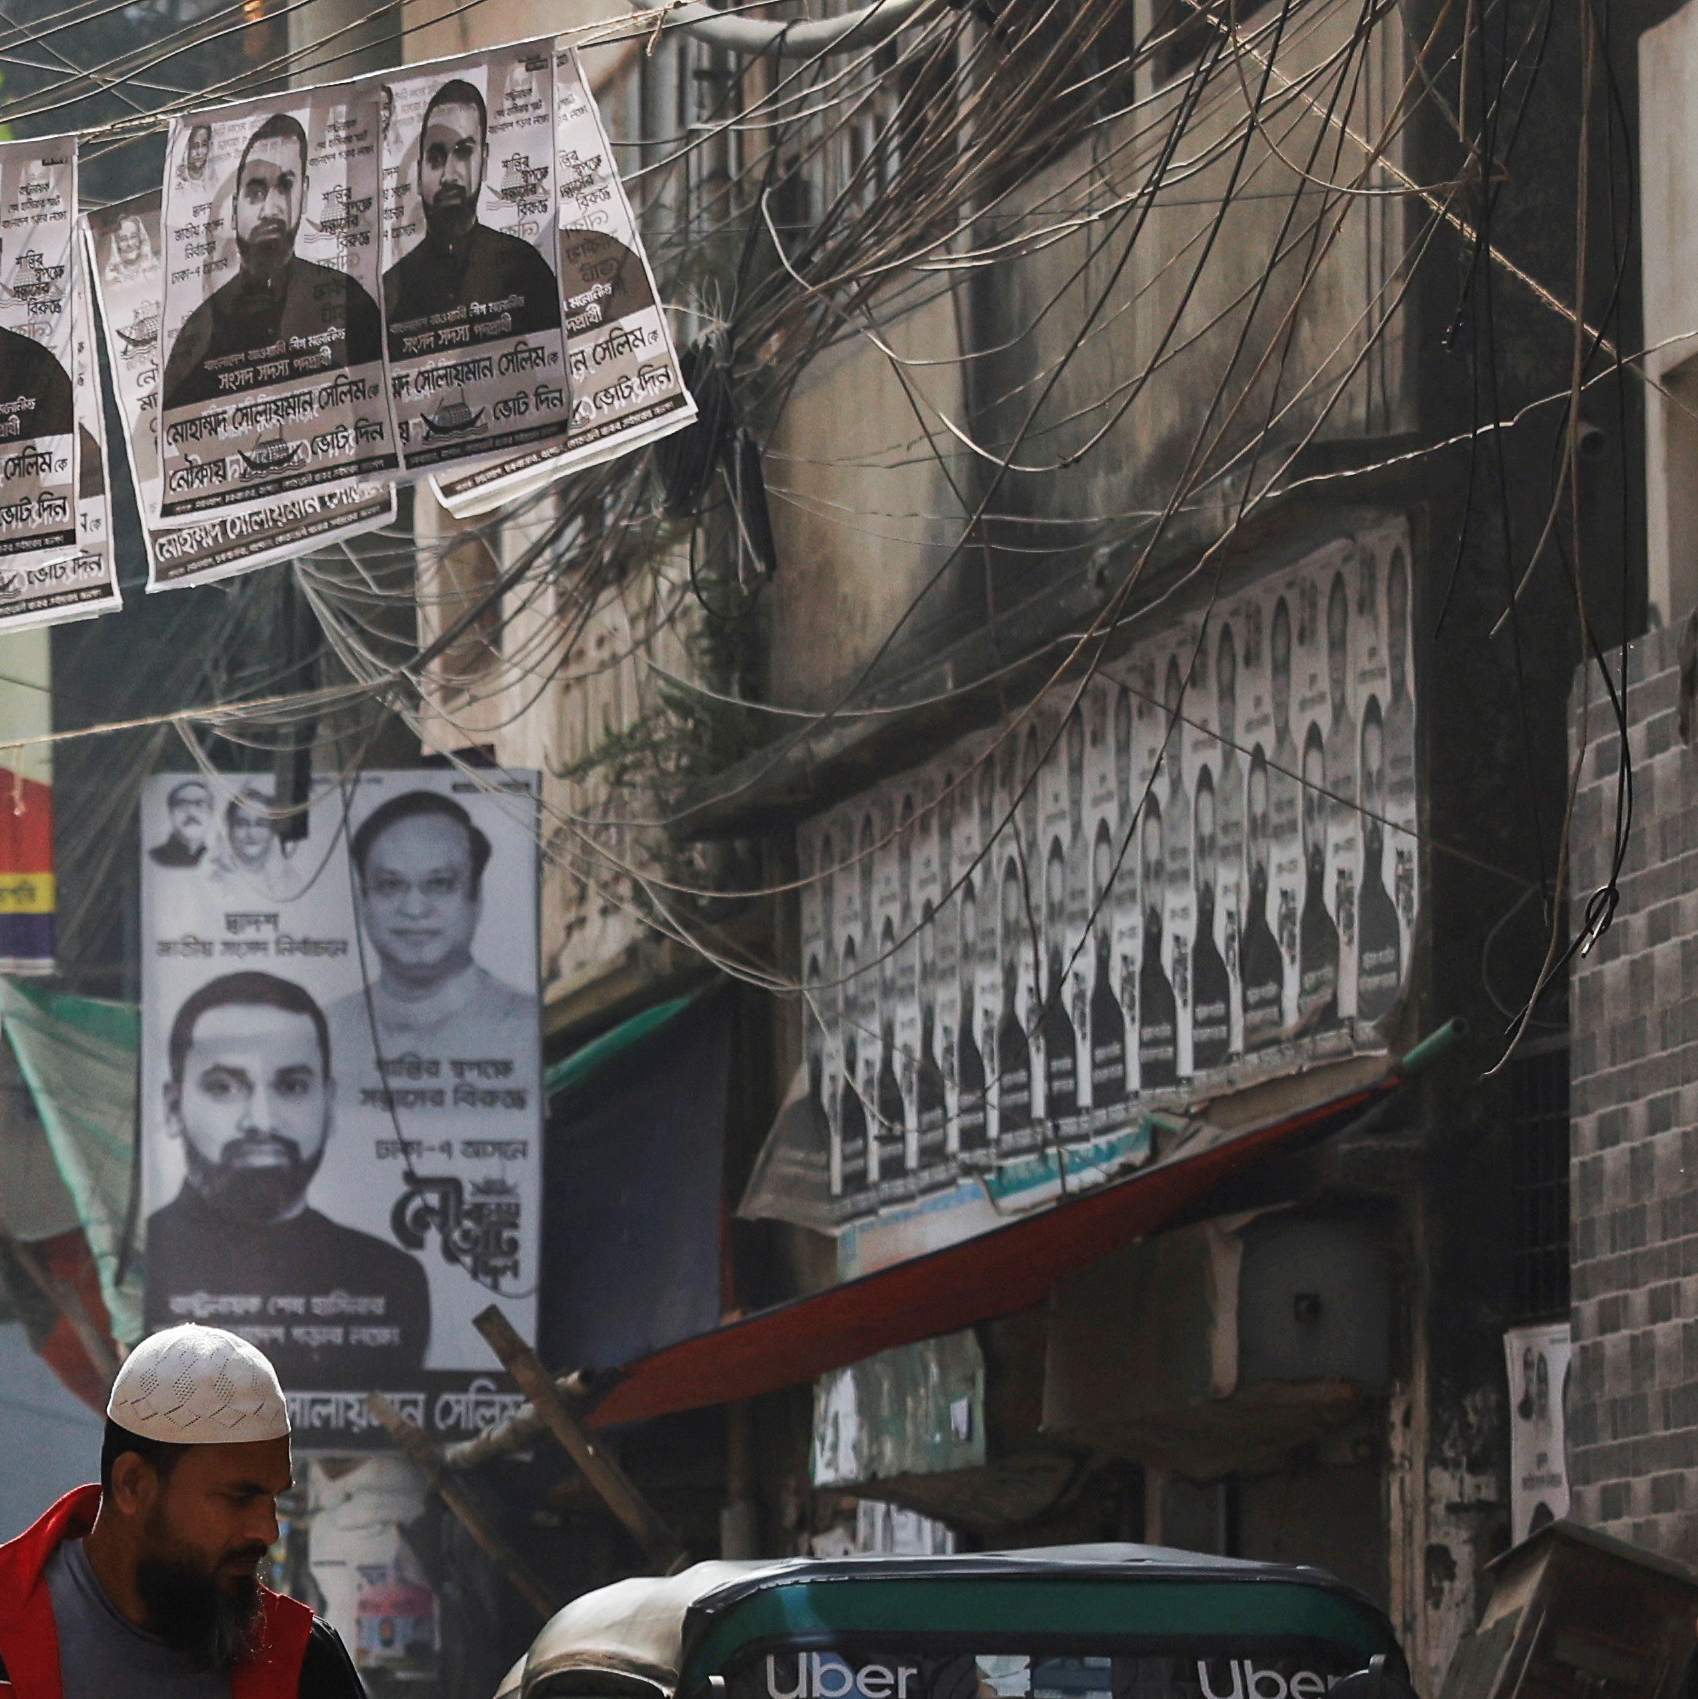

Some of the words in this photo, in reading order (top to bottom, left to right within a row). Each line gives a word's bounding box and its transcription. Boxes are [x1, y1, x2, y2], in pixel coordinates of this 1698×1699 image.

[592, 326, 647, 367] সেলিম
[592, 379, 635, 411] ভোট
[638, 364, 673, 391] দিন
[166, 410, 228, 447] মোহাম্মদ
[231, 389, 314, 430] সোলায়মান
[318, 375, 366, 410] সেলিম
[311, 423, 350, 456] ভোট
[353, 418, 384, 445] দিন
[3, 445, 53, 480] সেলিম
[37, 491, 68, 518] দিন
[155, 519, 221, 564] মোহাম্মদ
[226, 495, 321, 540] সোলায়মান
[765, 1652, 919, 1699] Uber
